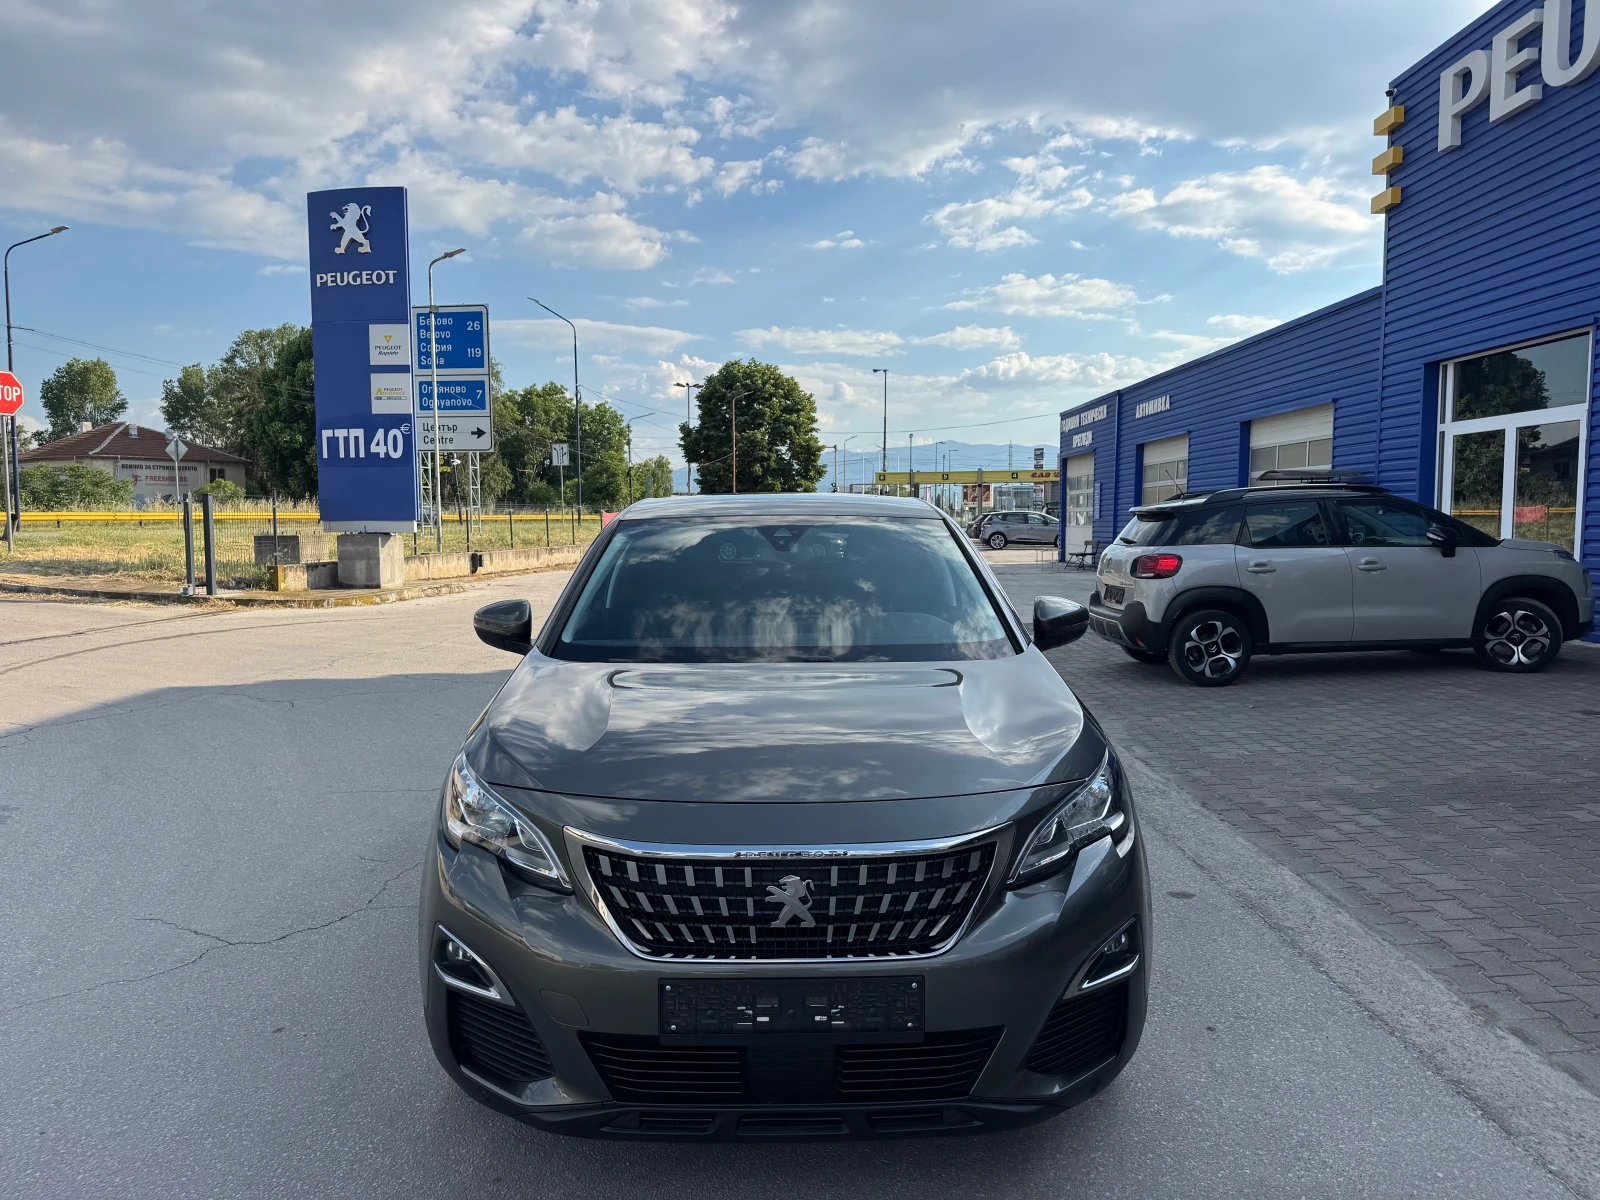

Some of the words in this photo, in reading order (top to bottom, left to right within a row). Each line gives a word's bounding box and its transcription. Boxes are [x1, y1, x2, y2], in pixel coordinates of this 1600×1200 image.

[1438, 0, 1600, 152] PEU
[316, 270, 397, 287] PEUGEOT
[419, 316, 453, 326] Беово
[466, 321, 481, 331] 26
[420, 329, 451, 339] Beovo
[420, 355, 445, 365] Soia
[467, 348, 482, 358] 119
[421, 384, 467, 394] Огяново
[476, 389, 483, 399] 7
[321, 428, 365, 459] ГТП
[745, 850, 838, 859] PEUGEOT
